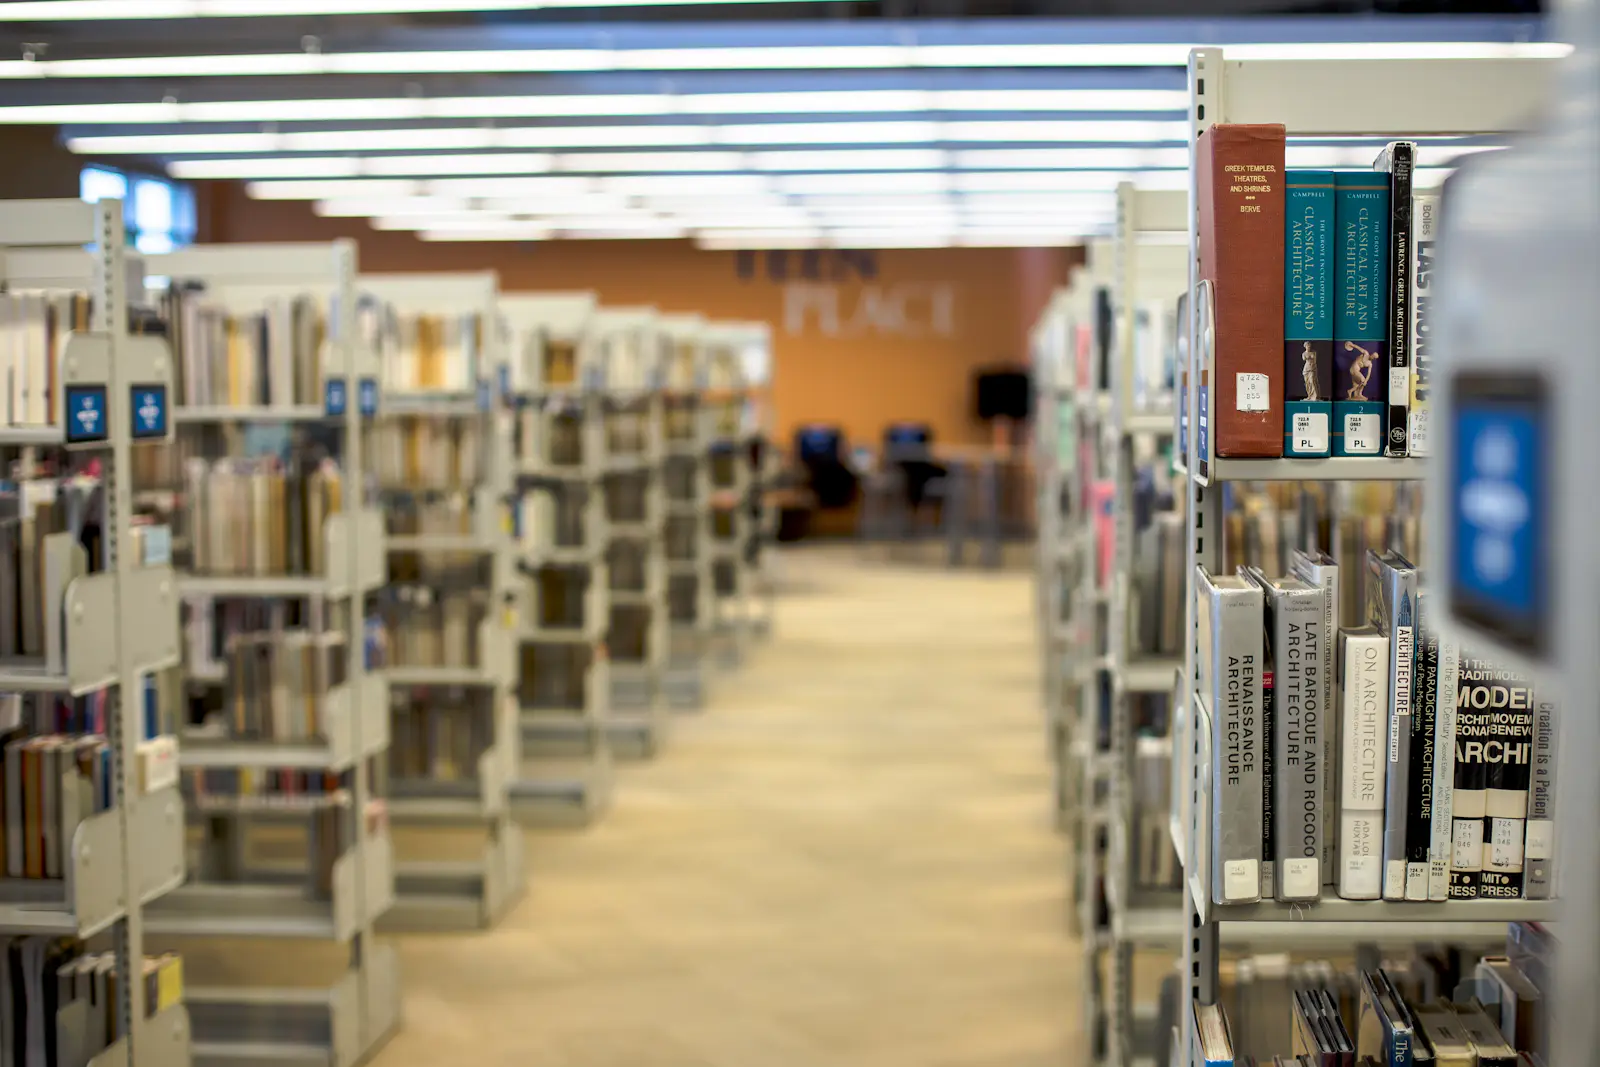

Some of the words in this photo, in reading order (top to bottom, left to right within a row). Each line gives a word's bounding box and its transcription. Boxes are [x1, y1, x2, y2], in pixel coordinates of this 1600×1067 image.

[1246, 165, 1276, 173] TEMPLES,
[1422, 205, 1432, 236] Bolles
[1304, 206, 1314, 270] CLASSICAL
[1358, 208, 1368, 272] CLASSICAL
[1292, 220, 1302, 316] ARCHITECTURE
[1346, 222, 1356, 316] ARCHITECTURE
[1416, 241, 1436, 290] LAS
[1304, 274, 1314, 298] ART
[1358, 276, 1368, 299] ART
[1304, 302, 1314, 330] AND
[1320, 310, 1324, 318] OF
[1358, 303, 1368, 330] AND
[1305, 622, 1316, 660] LATE
[1428, 636, 1438, 664] NEW
[1364, 647, 1378, 672] ON
[1396, 630, 1410, 713] ARCHITECTURE
[1418, 664, 1424, 672] of
[1446, 656, 1454, 666] of
[1464, 659, 1469, 668] 1
[1445, 668, 1454, 682] the
[1264, 694, 1272, 708] The
[1288, 623, 1300, 766] ARCHITECTURE
[1304, 667, 1316, 744] BAROQUE
[1415, 673, 1424, 731] Post-Modernism
[1425, 666, 1436, 722] PARADIGM
[1444, 684, 1454, 704] 20th
[1228, 656, 1238, 786] ARCHITECTURE
[1242, 655, 1254, 772] RENAISSANCE
[1441, 706, 1453, 740] Century
[1490, 713, 1532, 724] MOVEM
[1538, 702, 1554, 750] Creation
[1264, 710, 1272, 751] Architecture
[1362, 678, 1376, 800] ARCHITECTURE
[1424, 724, 1434, 736] IN
[1490, 724, 1532, 736] BENEV
[1264, 752, 1271, 760] of
[1304, 750, 1316, 784] AND
[1538, 754, 1552, 764] is
[1421, 738, 1433, 818] ARCHITECTURE
[1264, 774, 1272, 811] Eighteenth
[1262, 812, 1271, 840] Century
[1304, 790, 1316, 856] ROCOCO
[1448, 886, 1476, 896] RESS
[1481, 886, 1518, 896] PRESS
[1482, 874, 1502, 884] MIT
[1396, 1040, 1408, 1062] The
